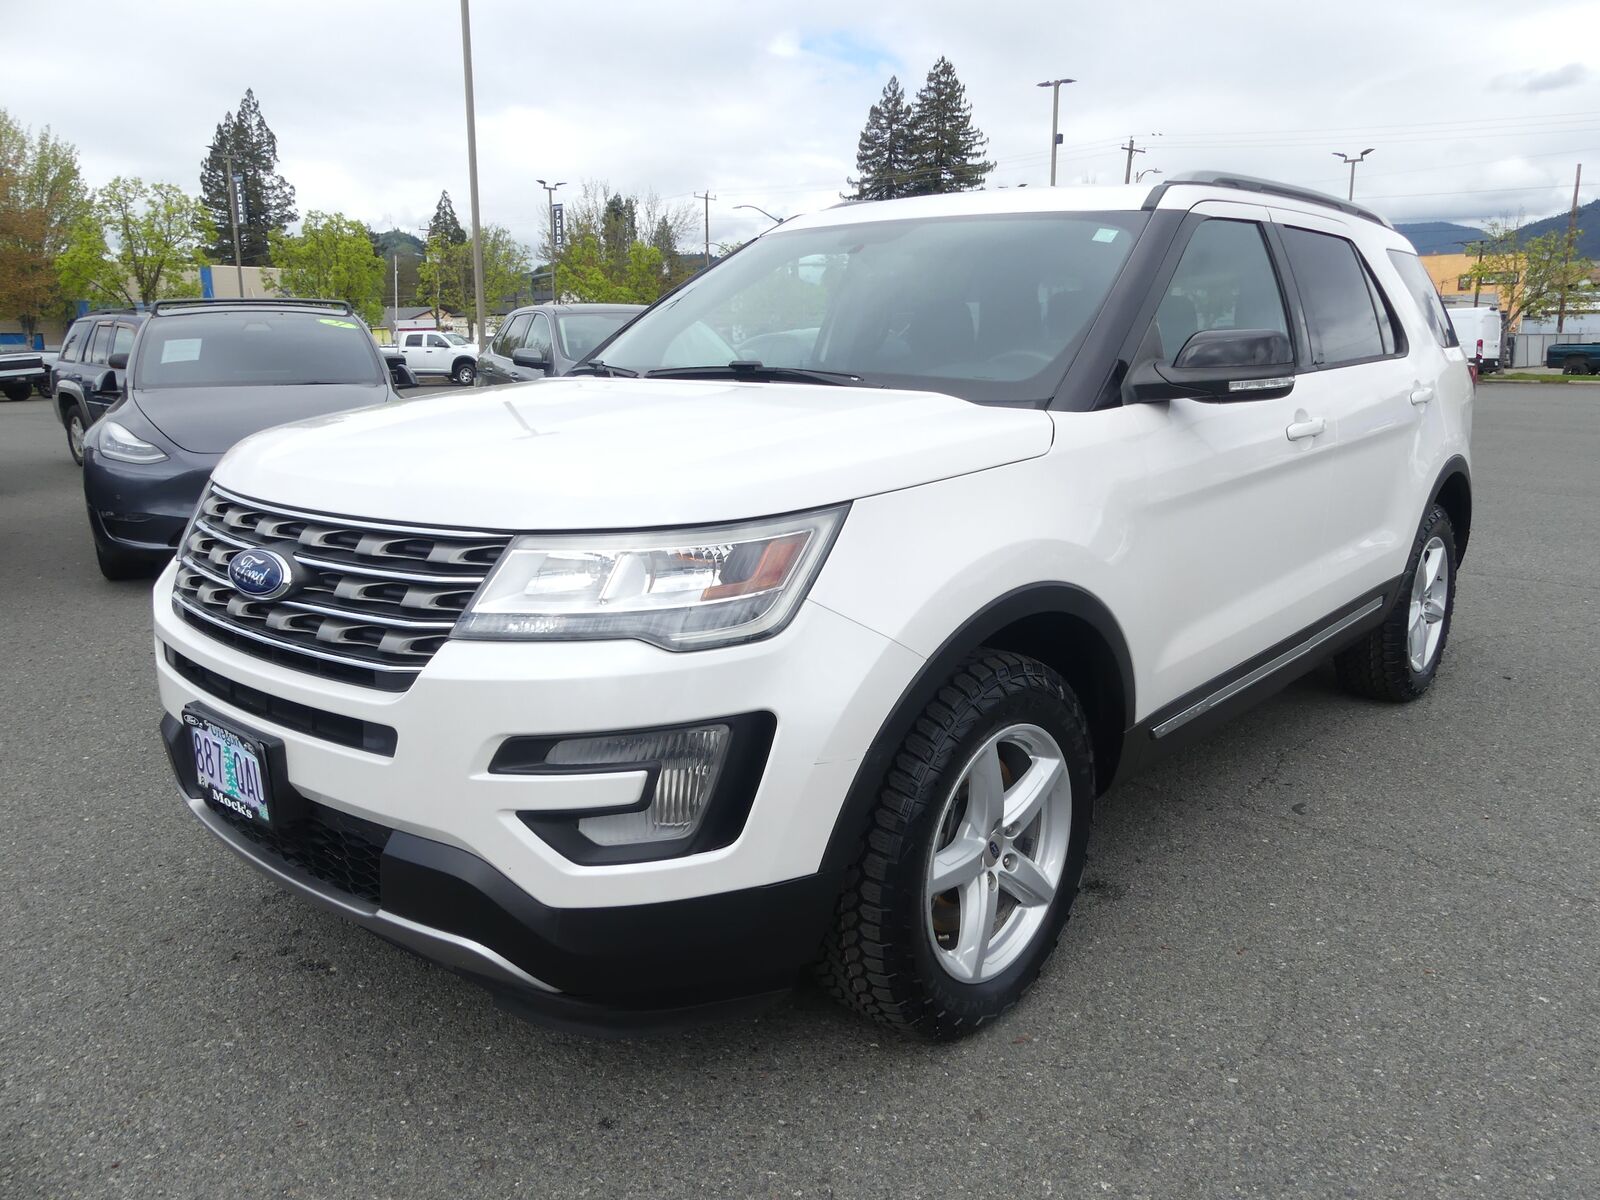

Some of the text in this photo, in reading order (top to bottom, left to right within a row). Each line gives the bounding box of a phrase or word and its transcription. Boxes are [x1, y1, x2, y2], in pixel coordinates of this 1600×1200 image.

[236, 183, 244, 224] FORD
[235, 555, 271, 586] Ford
[194, 732, 223, 784] 887
[212, 788, 253, 819] Mock's
